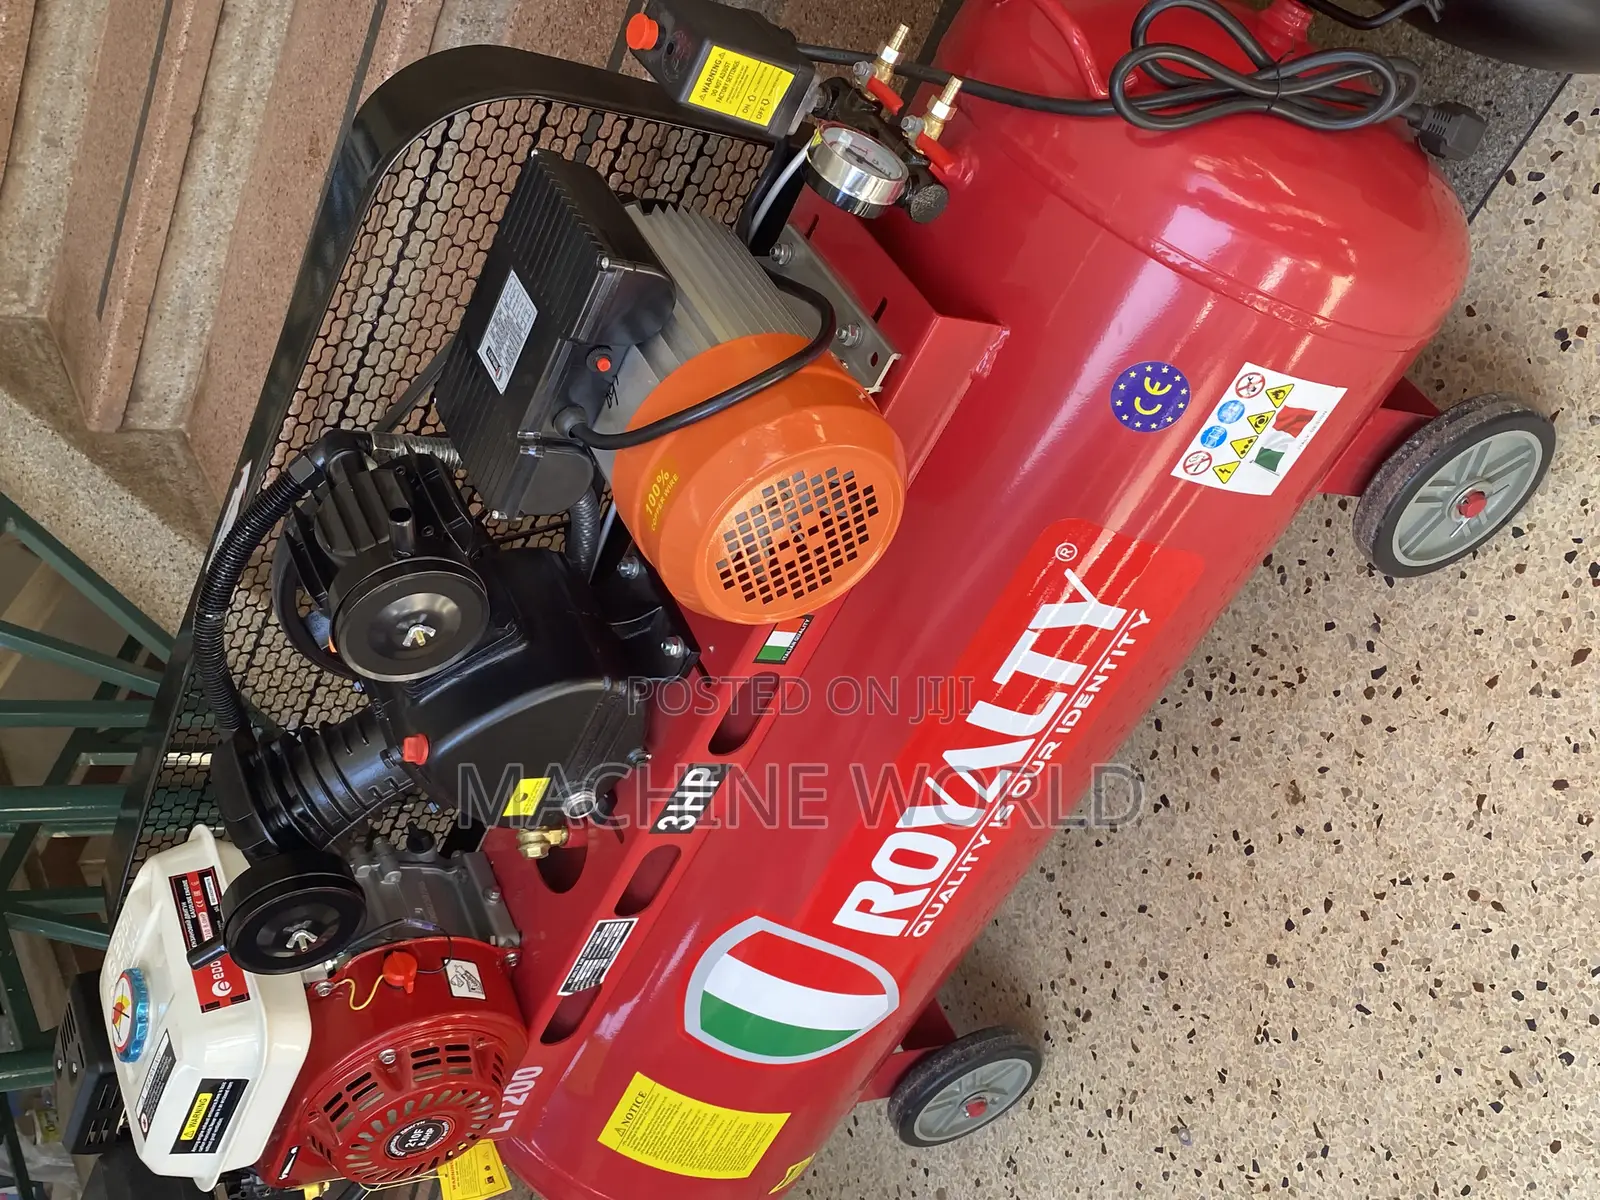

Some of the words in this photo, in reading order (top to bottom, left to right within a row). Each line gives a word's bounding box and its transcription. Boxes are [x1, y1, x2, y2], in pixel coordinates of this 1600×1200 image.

[701, 59, 722, 94] WARNING
[714, 78, 723, 89] NOT
[718, 61, 731, 79] ADJUST
[715, 82, 729, 103] FACTORY
[742, 103, 751, 114] ON
[755, 106, 766, 120] OFF
[643, 468, 670, 514] 100%
[650, 495, 667, 531] COPPER
[663, 472, 680, 495] WIRE
[780, 641, 797, 661] ITALIAN
[793, 618, 810, 641] QUALITY
[832, 568, 1127, 937] ROYALTY
[912, 833, 991, 938] QUALITY
[989, 804, 1015, 827] IS
[1011, 741, 1062, 799] OUR
[1055, 610, 1151, 734] IDENTITY
[658, 767, 719, 829] 3HP
[189, 1098, 208, 1128] WARNING
[621, 1090, 648, 1127] NOTICE
[404, 1127, 424, 1148] 210F
